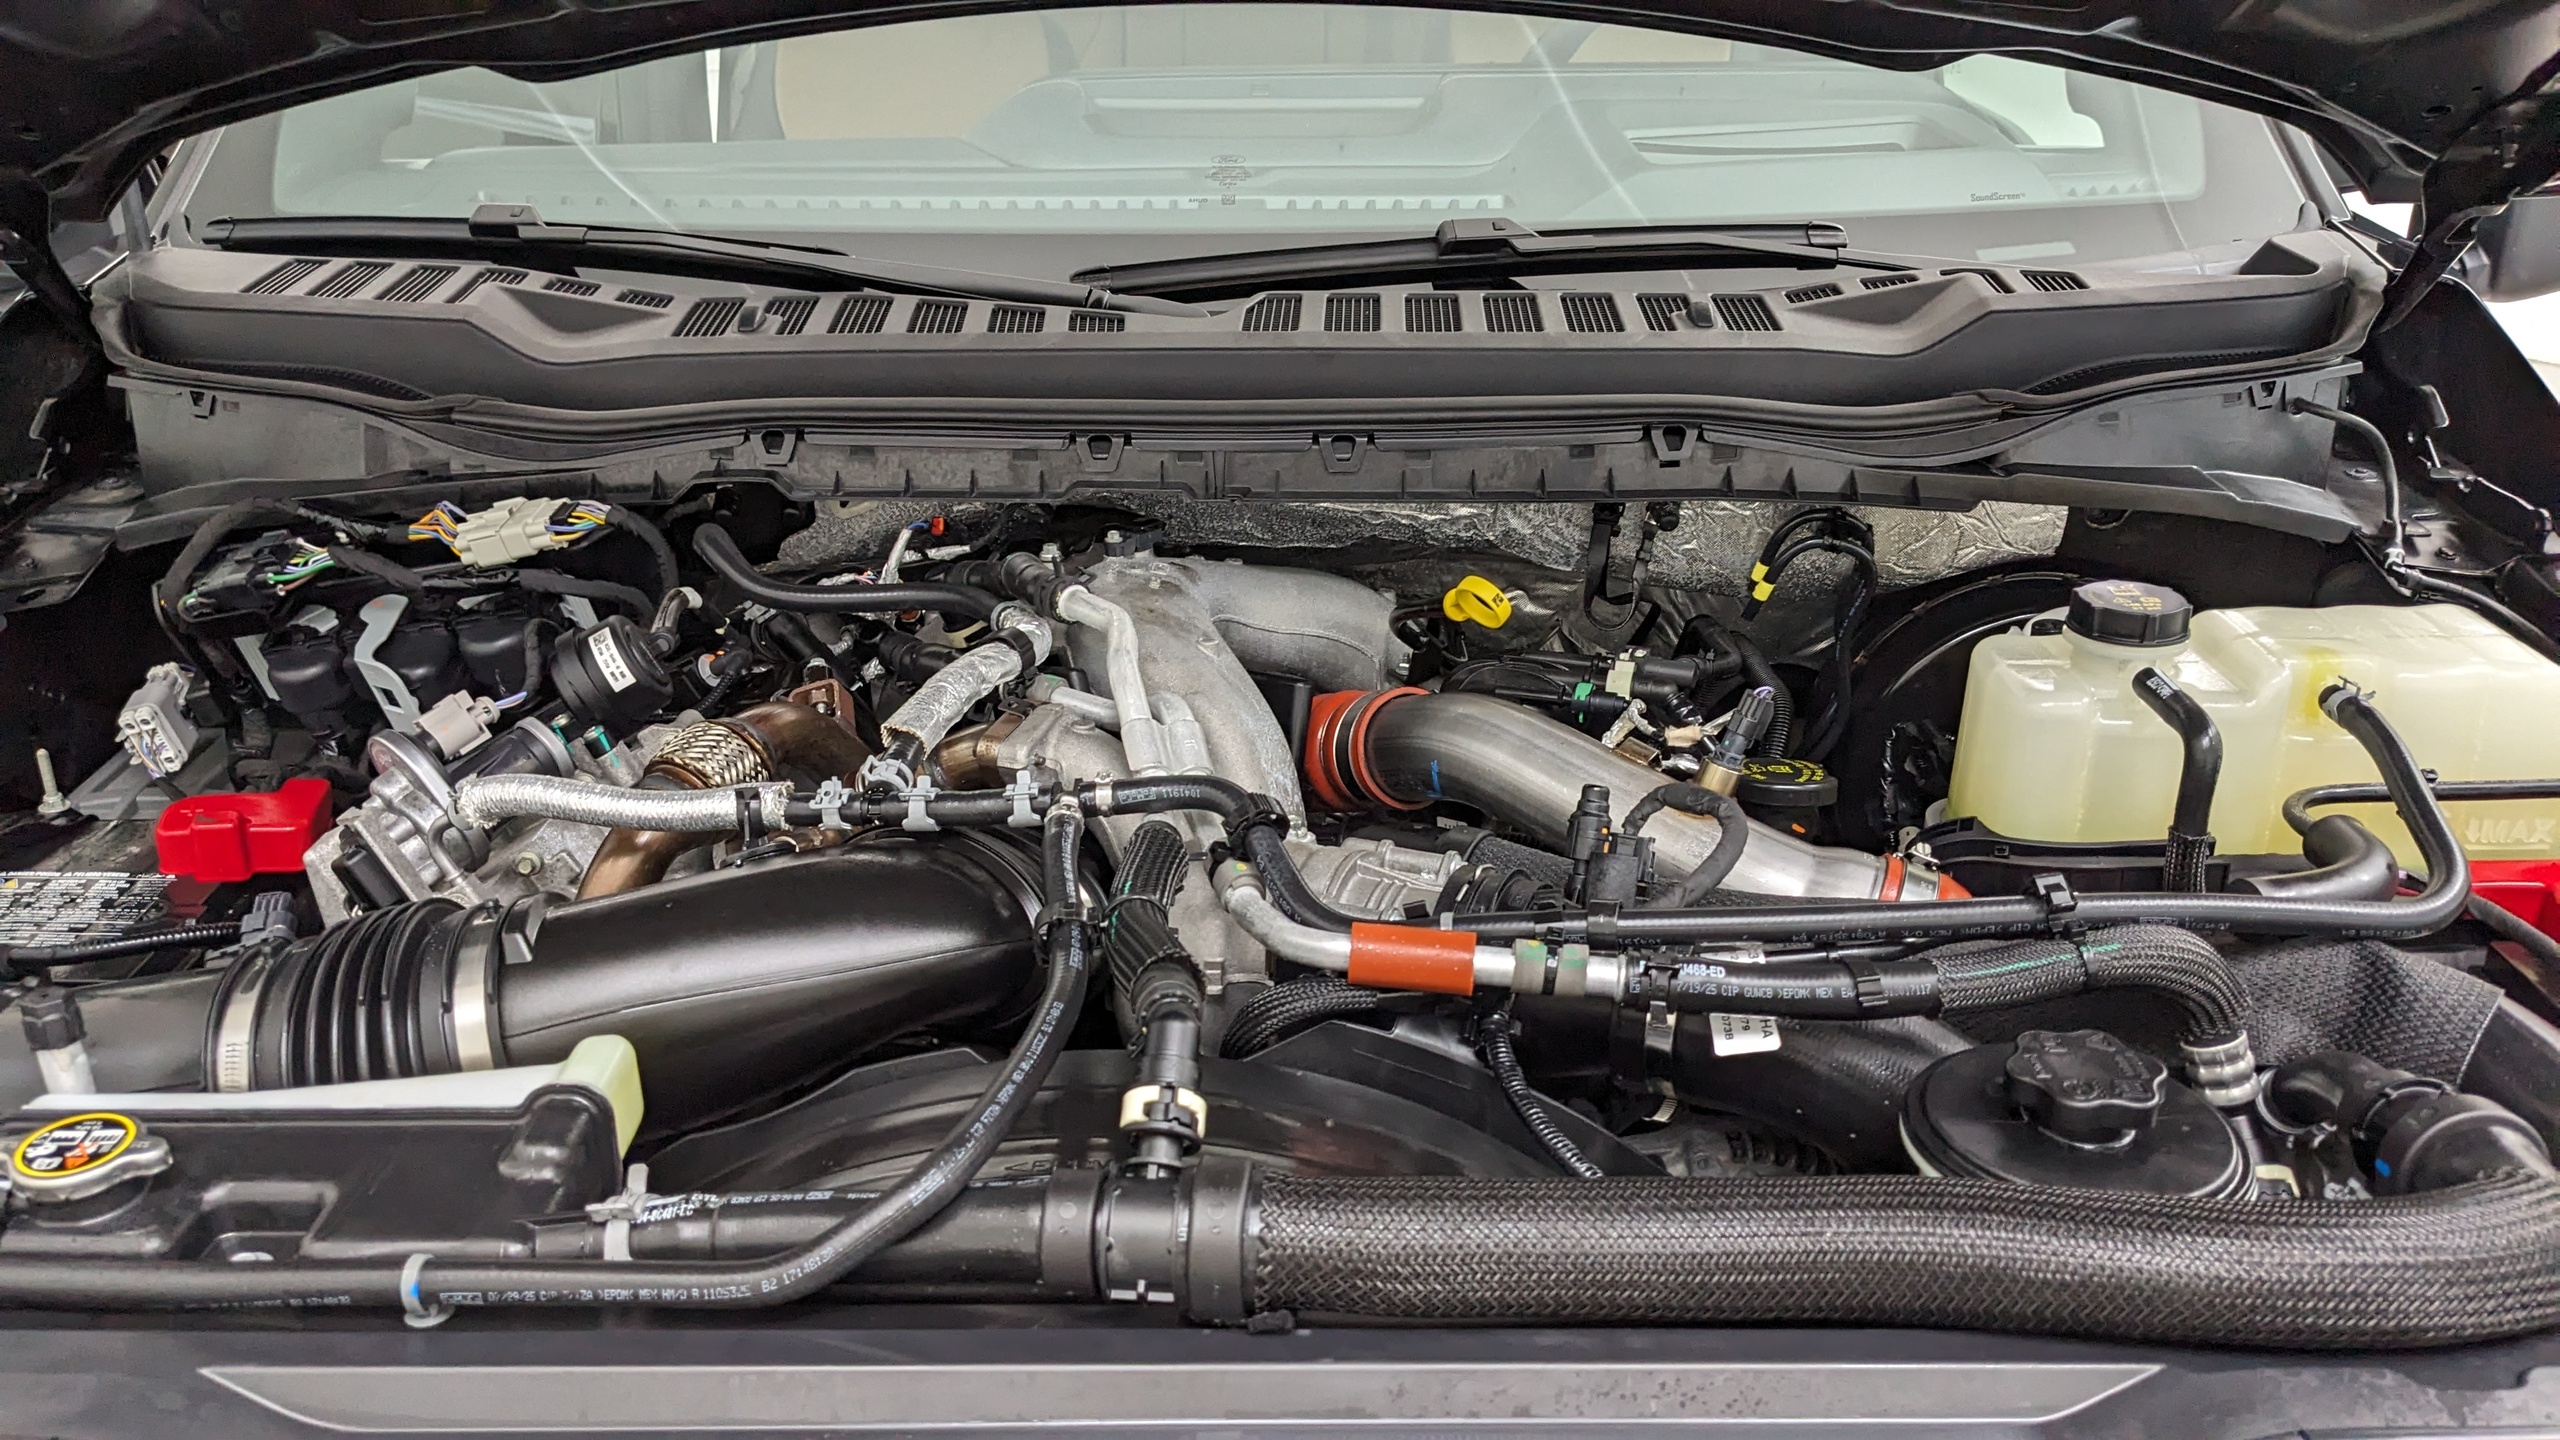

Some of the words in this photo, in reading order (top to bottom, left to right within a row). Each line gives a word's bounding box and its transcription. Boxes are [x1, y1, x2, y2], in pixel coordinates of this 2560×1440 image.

[1119, 787, 1157, 804] FoMoCo
[1161, 788, 1200, 798] 1041911
[1721, 984, 1740, 997] CIP
[1815, 986, 1833, 998] MEX
[760, 1278, 779, 1294] B2
